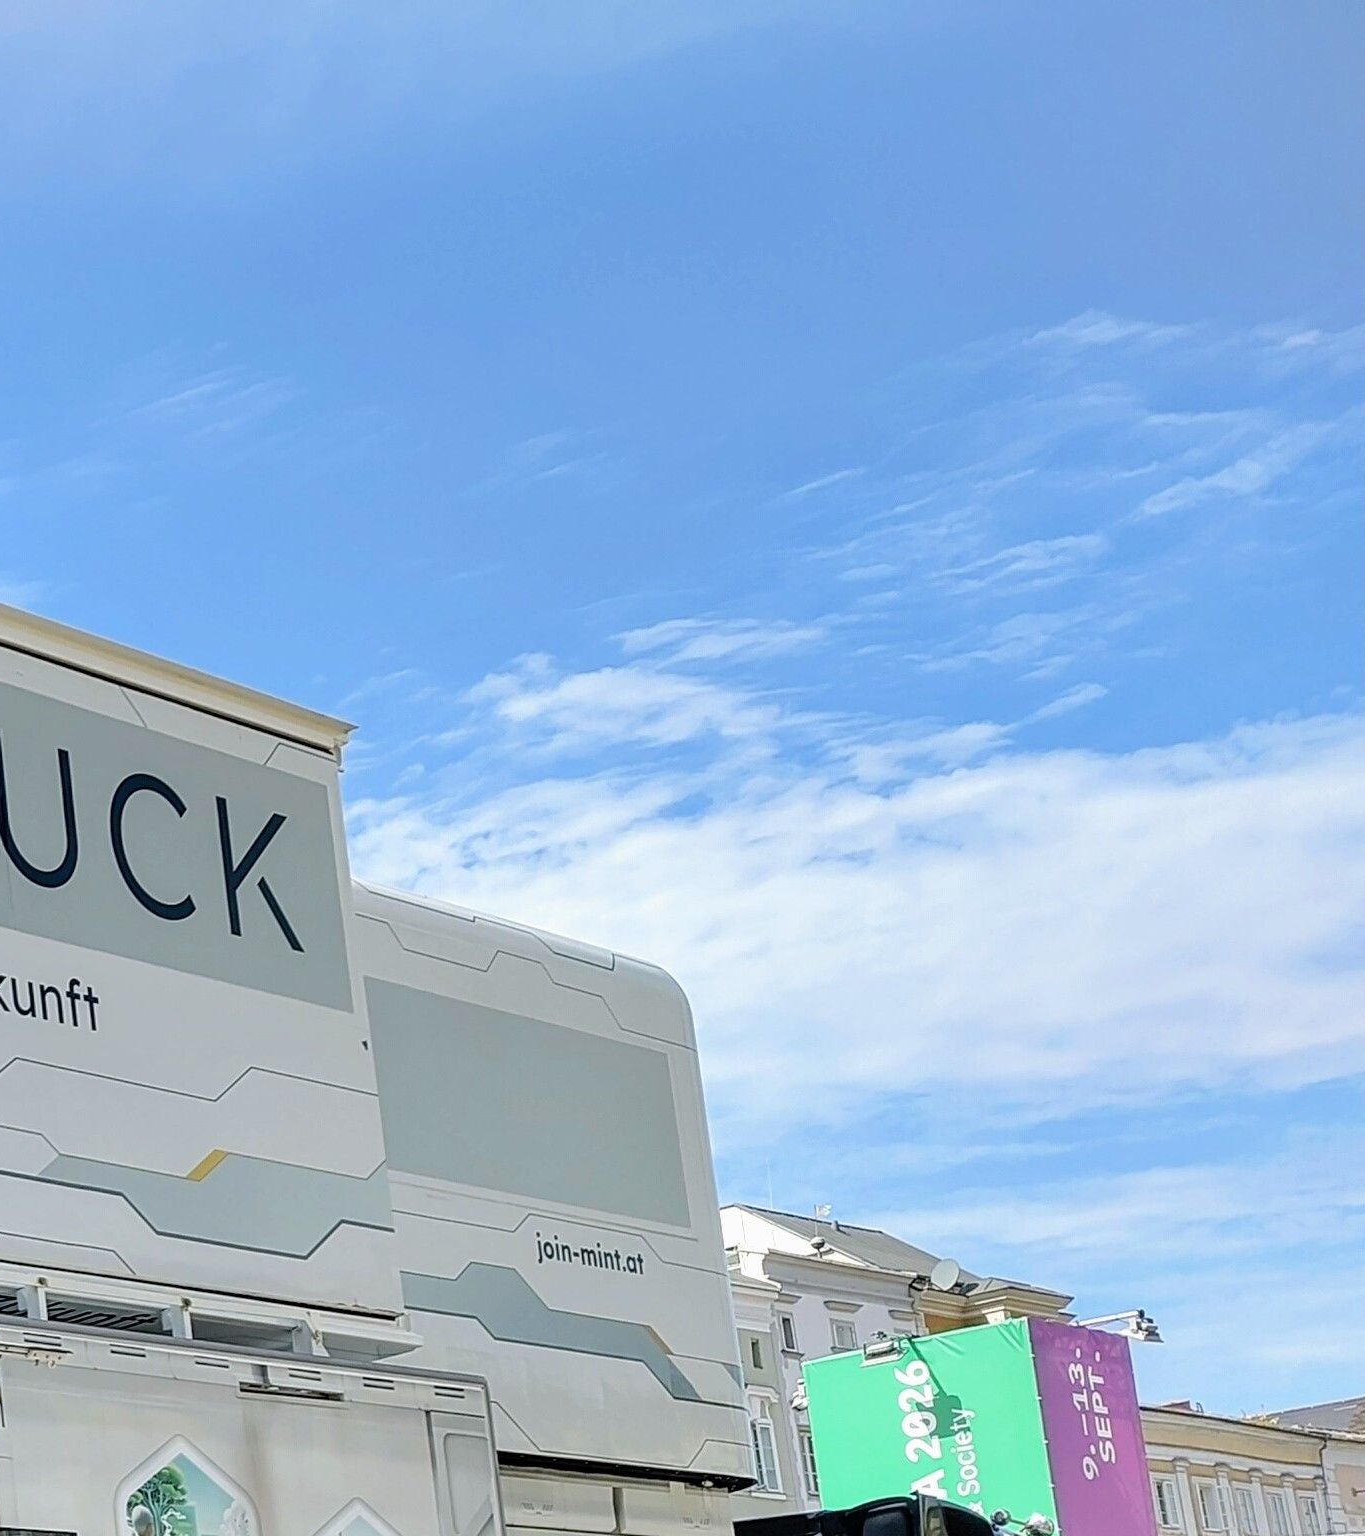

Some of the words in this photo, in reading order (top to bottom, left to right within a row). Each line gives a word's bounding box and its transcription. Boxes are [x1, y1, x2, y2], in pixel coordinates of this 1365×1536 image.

[536, 1231, 644, 1275] join-mint.at
[893, 1359, 943, 1464] 2026
[950, 1408, 981, 1497] Society
[1087, 1350, 1116, 1465] SEPT.
